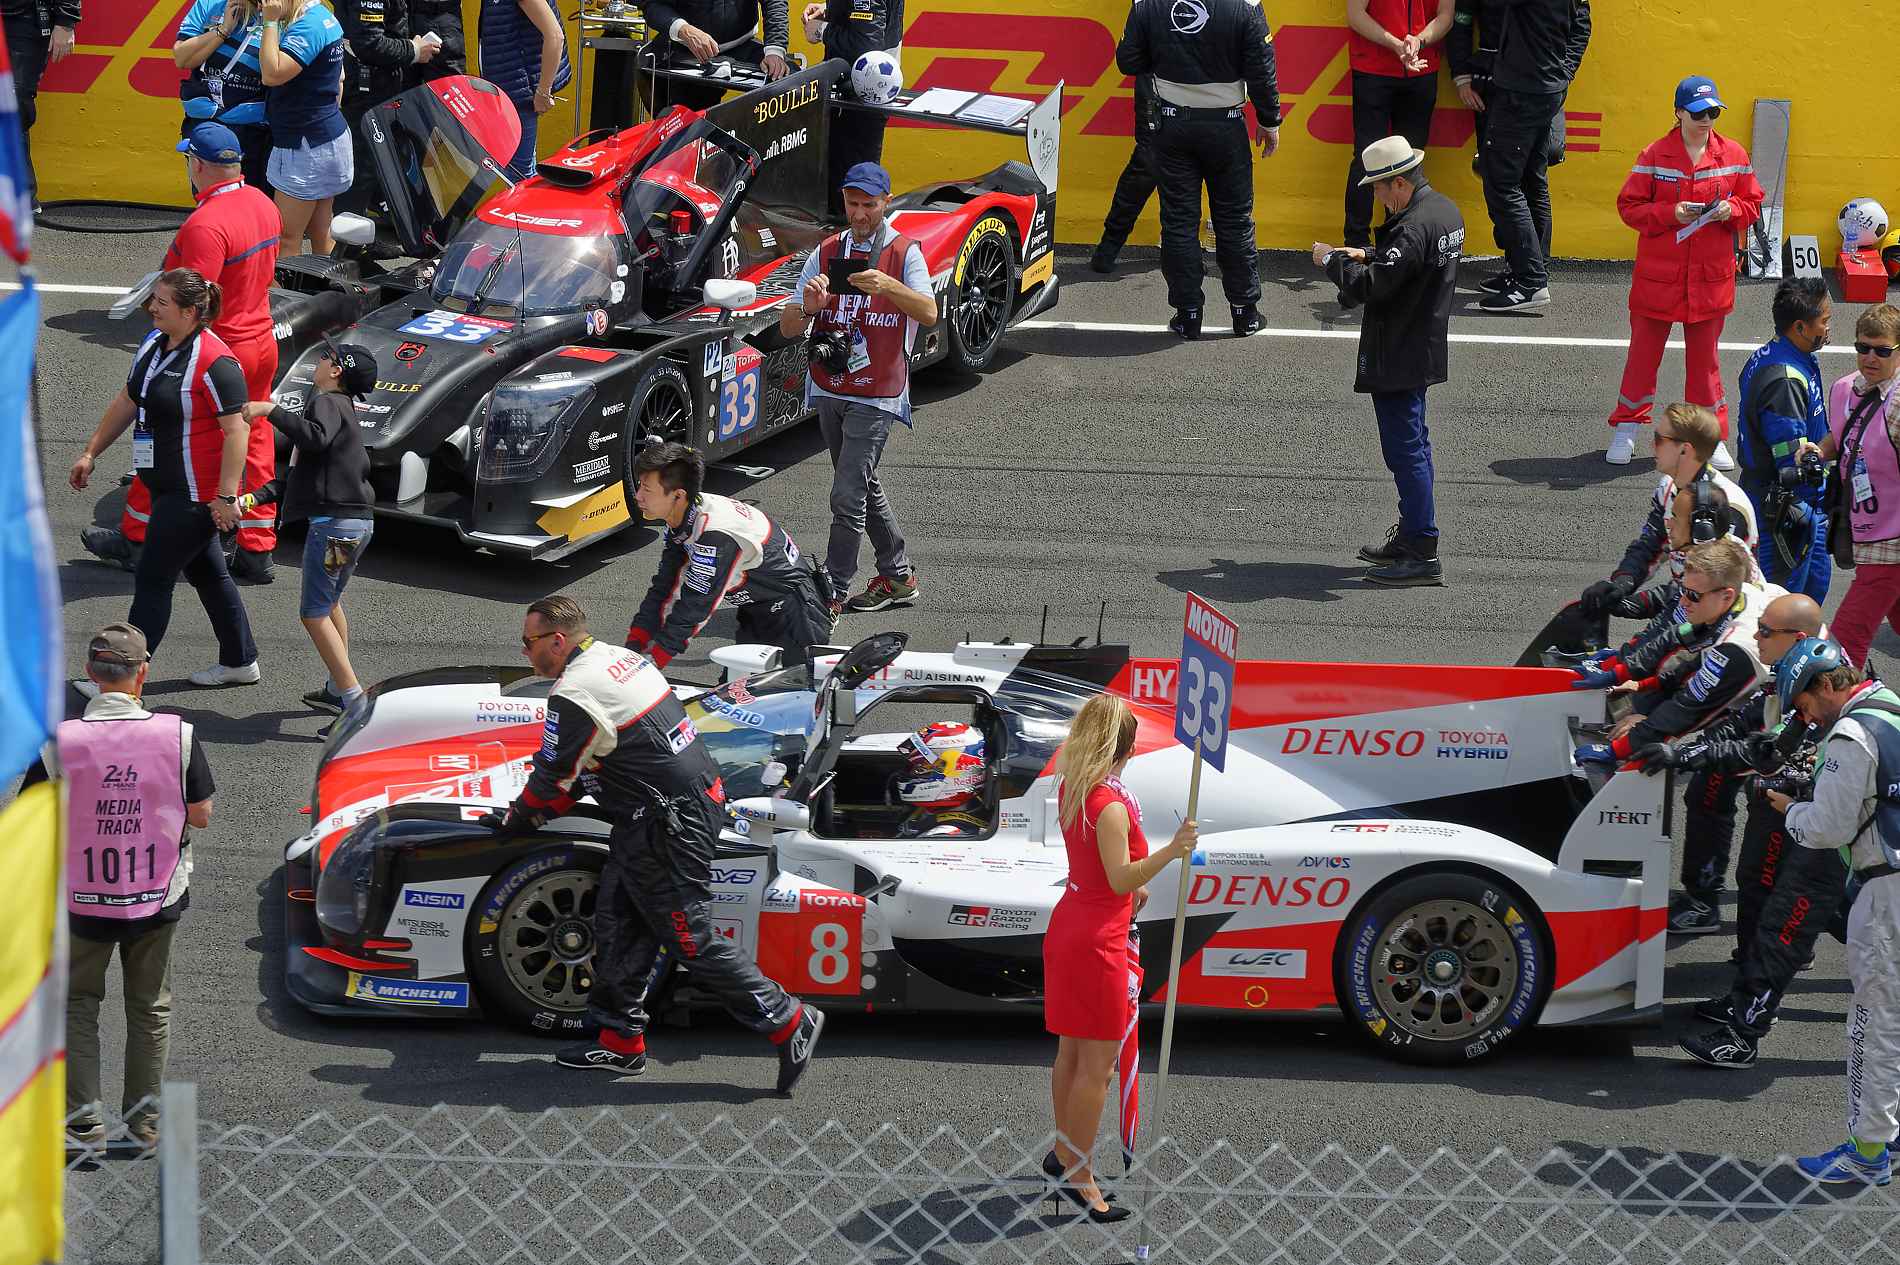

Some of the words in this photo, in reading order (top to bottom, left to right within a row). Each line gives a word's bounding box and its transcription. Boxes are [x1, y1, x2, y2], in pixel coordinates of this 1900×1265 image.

[780, 127, 807, 152] RBMG
[961, 217, 1004, 262] DUNLOP
[1794, 246, 1819, 269] 50
[462, 316, 507, 328] TOTAL
[864, 311, 900, 327] TRACK
[406, 317, 492, 341] 33
[706, 342, 721, 371] P2
[721, 372, 757, 435] 33
[575, 457, 609, 476] MERIDIAN
[588, 500, 621, 520] DUNLOP
[1187, 602, 1237, 657] MOTUL
[607, 650, 642, 681] DENSO
[925, 673, 962, 683] AISIN
[965, 675, 986, 683] AW
[1133, 668, 1177, 698] HY
[477, 701, 531, 712] TOYOTA
[535, 706, 545, 720] 8
[1181, 656, 1227, 753] 33
[475, 713, 532, 723] HYBRID
[1280, 727, 1425, 757] DENSO
[1439, 730, 1509, 745] TOYOTA
[1436, 746, 1509, 760] HYBRID
[95, 798, 142, 816] MEDIA
[739, 806, 766, 819] Mobil
[1597, 808, 1652, 826] JTEKT
[96, 818, 144, 836] TRACK
[83, 843, 156, 884] 1011
[1296, 855, 1351, 869] ADVICS
[1760, 831, 1785, 889] DENSO
[493, 854, 568, 907] MICHELIN
[802, 892, 864, 907] TOTAL
[1187, 874, 1351, 908] DENSO
[407, 893, 462, 909] AISIN
[949, 913, 986, 926] GR
[990, 915, 1033, 923] GAZOO
[992, 908, 1040, 917] TOYOTA
[1778, 896, 1812, 946] DENSO
[397, 918, 445, 929] MITSUBISHI
[408, 927, 451, 938] ELECTRIC
[988, 921, 1030, 931] Racing
[807, 922, 850, 985] 8
[1228, 951, 1293, 966] WEC
[1351, 924, 1377, 1007] MICHELIN
[1511, 938, 1537, 1020] MICHELIN
[378, 985, 459, 1001] MICHELIN
